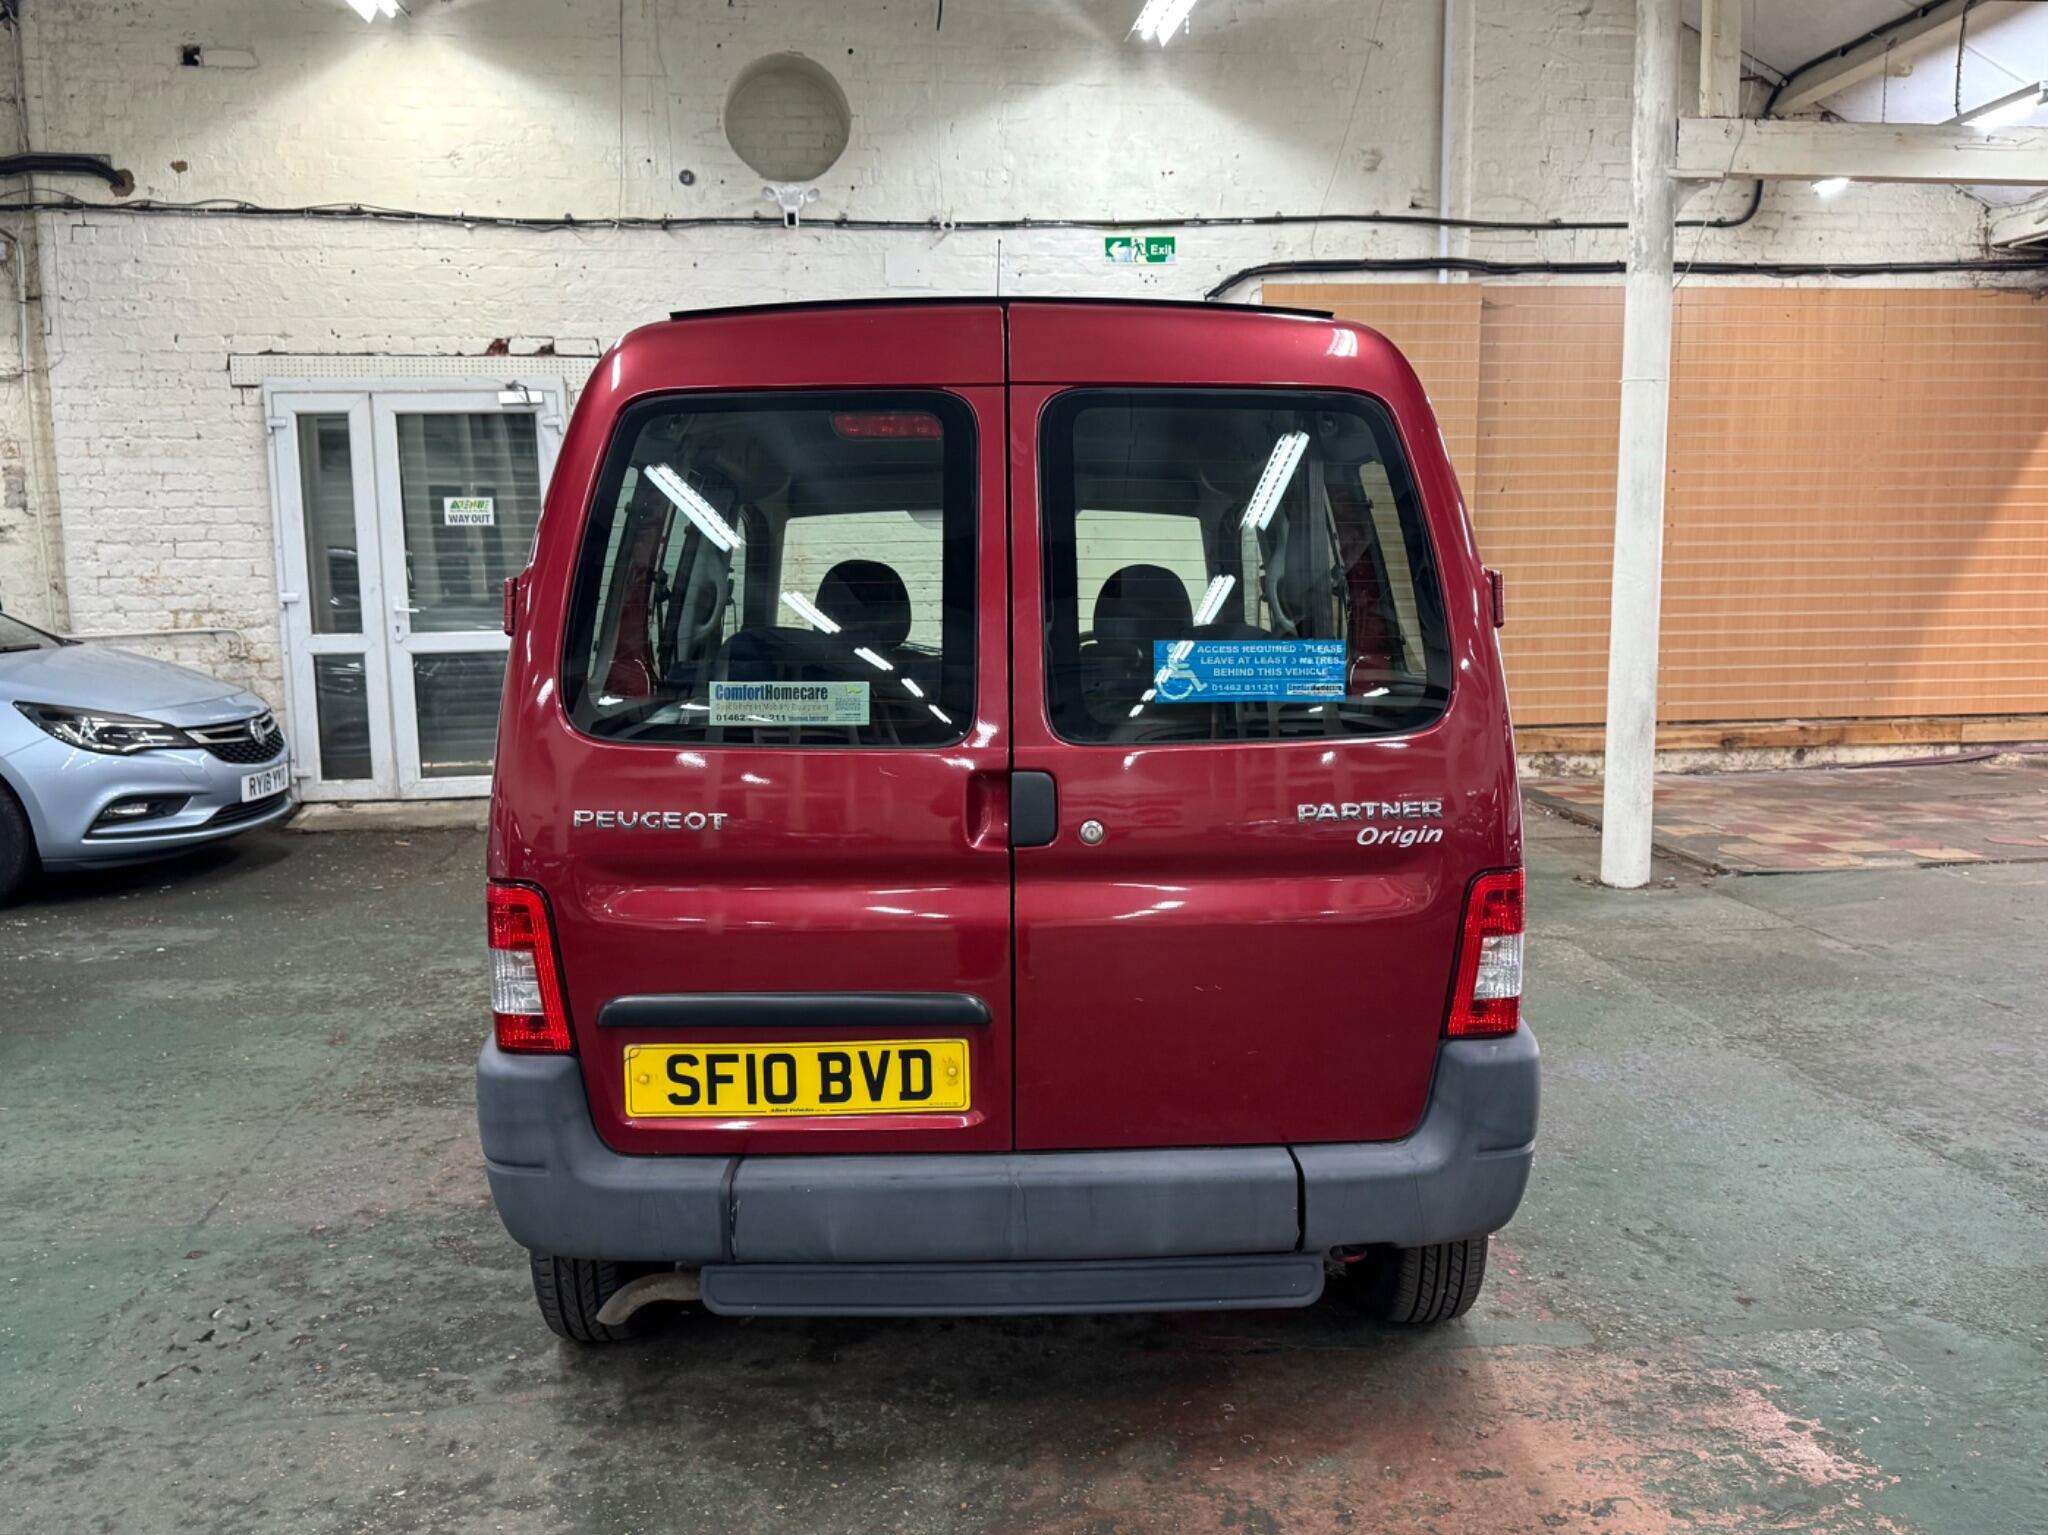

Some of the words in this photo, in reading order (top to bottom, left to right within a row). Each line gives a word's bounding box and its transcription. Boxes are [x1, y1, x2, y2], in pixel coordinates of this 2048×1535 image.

[448, 513, 470, 523] WAY
[471, 513, 491, 523] OUT
[1197, 645, 1239, 653] ACCESS
[1242, 645, 1296, 653] REQUIRED
[1304, 644, 1343, 654] PLEASE
[1200, 656, 1233, 665] LEAVE
[1238, 656, 1250, 665] AT
[1254, 656, 1287, 665] LEAST
[1213, 667, 1254, 677] BEHIND
[1257, 667, 1283, 676] THIS
[1285, 667, 1328, 676] VEHICLE
[715, 684, 828, 701] ComfortHomecare
[573, 809, 728, 830] PEUGEOT
[1297, 800, 1444, 823] PARTNER
[1356, 825, 1444, 848] Origin
[666, 1053, 797, 1106] SF10
[817, 1048, 933, 1104] BVD
